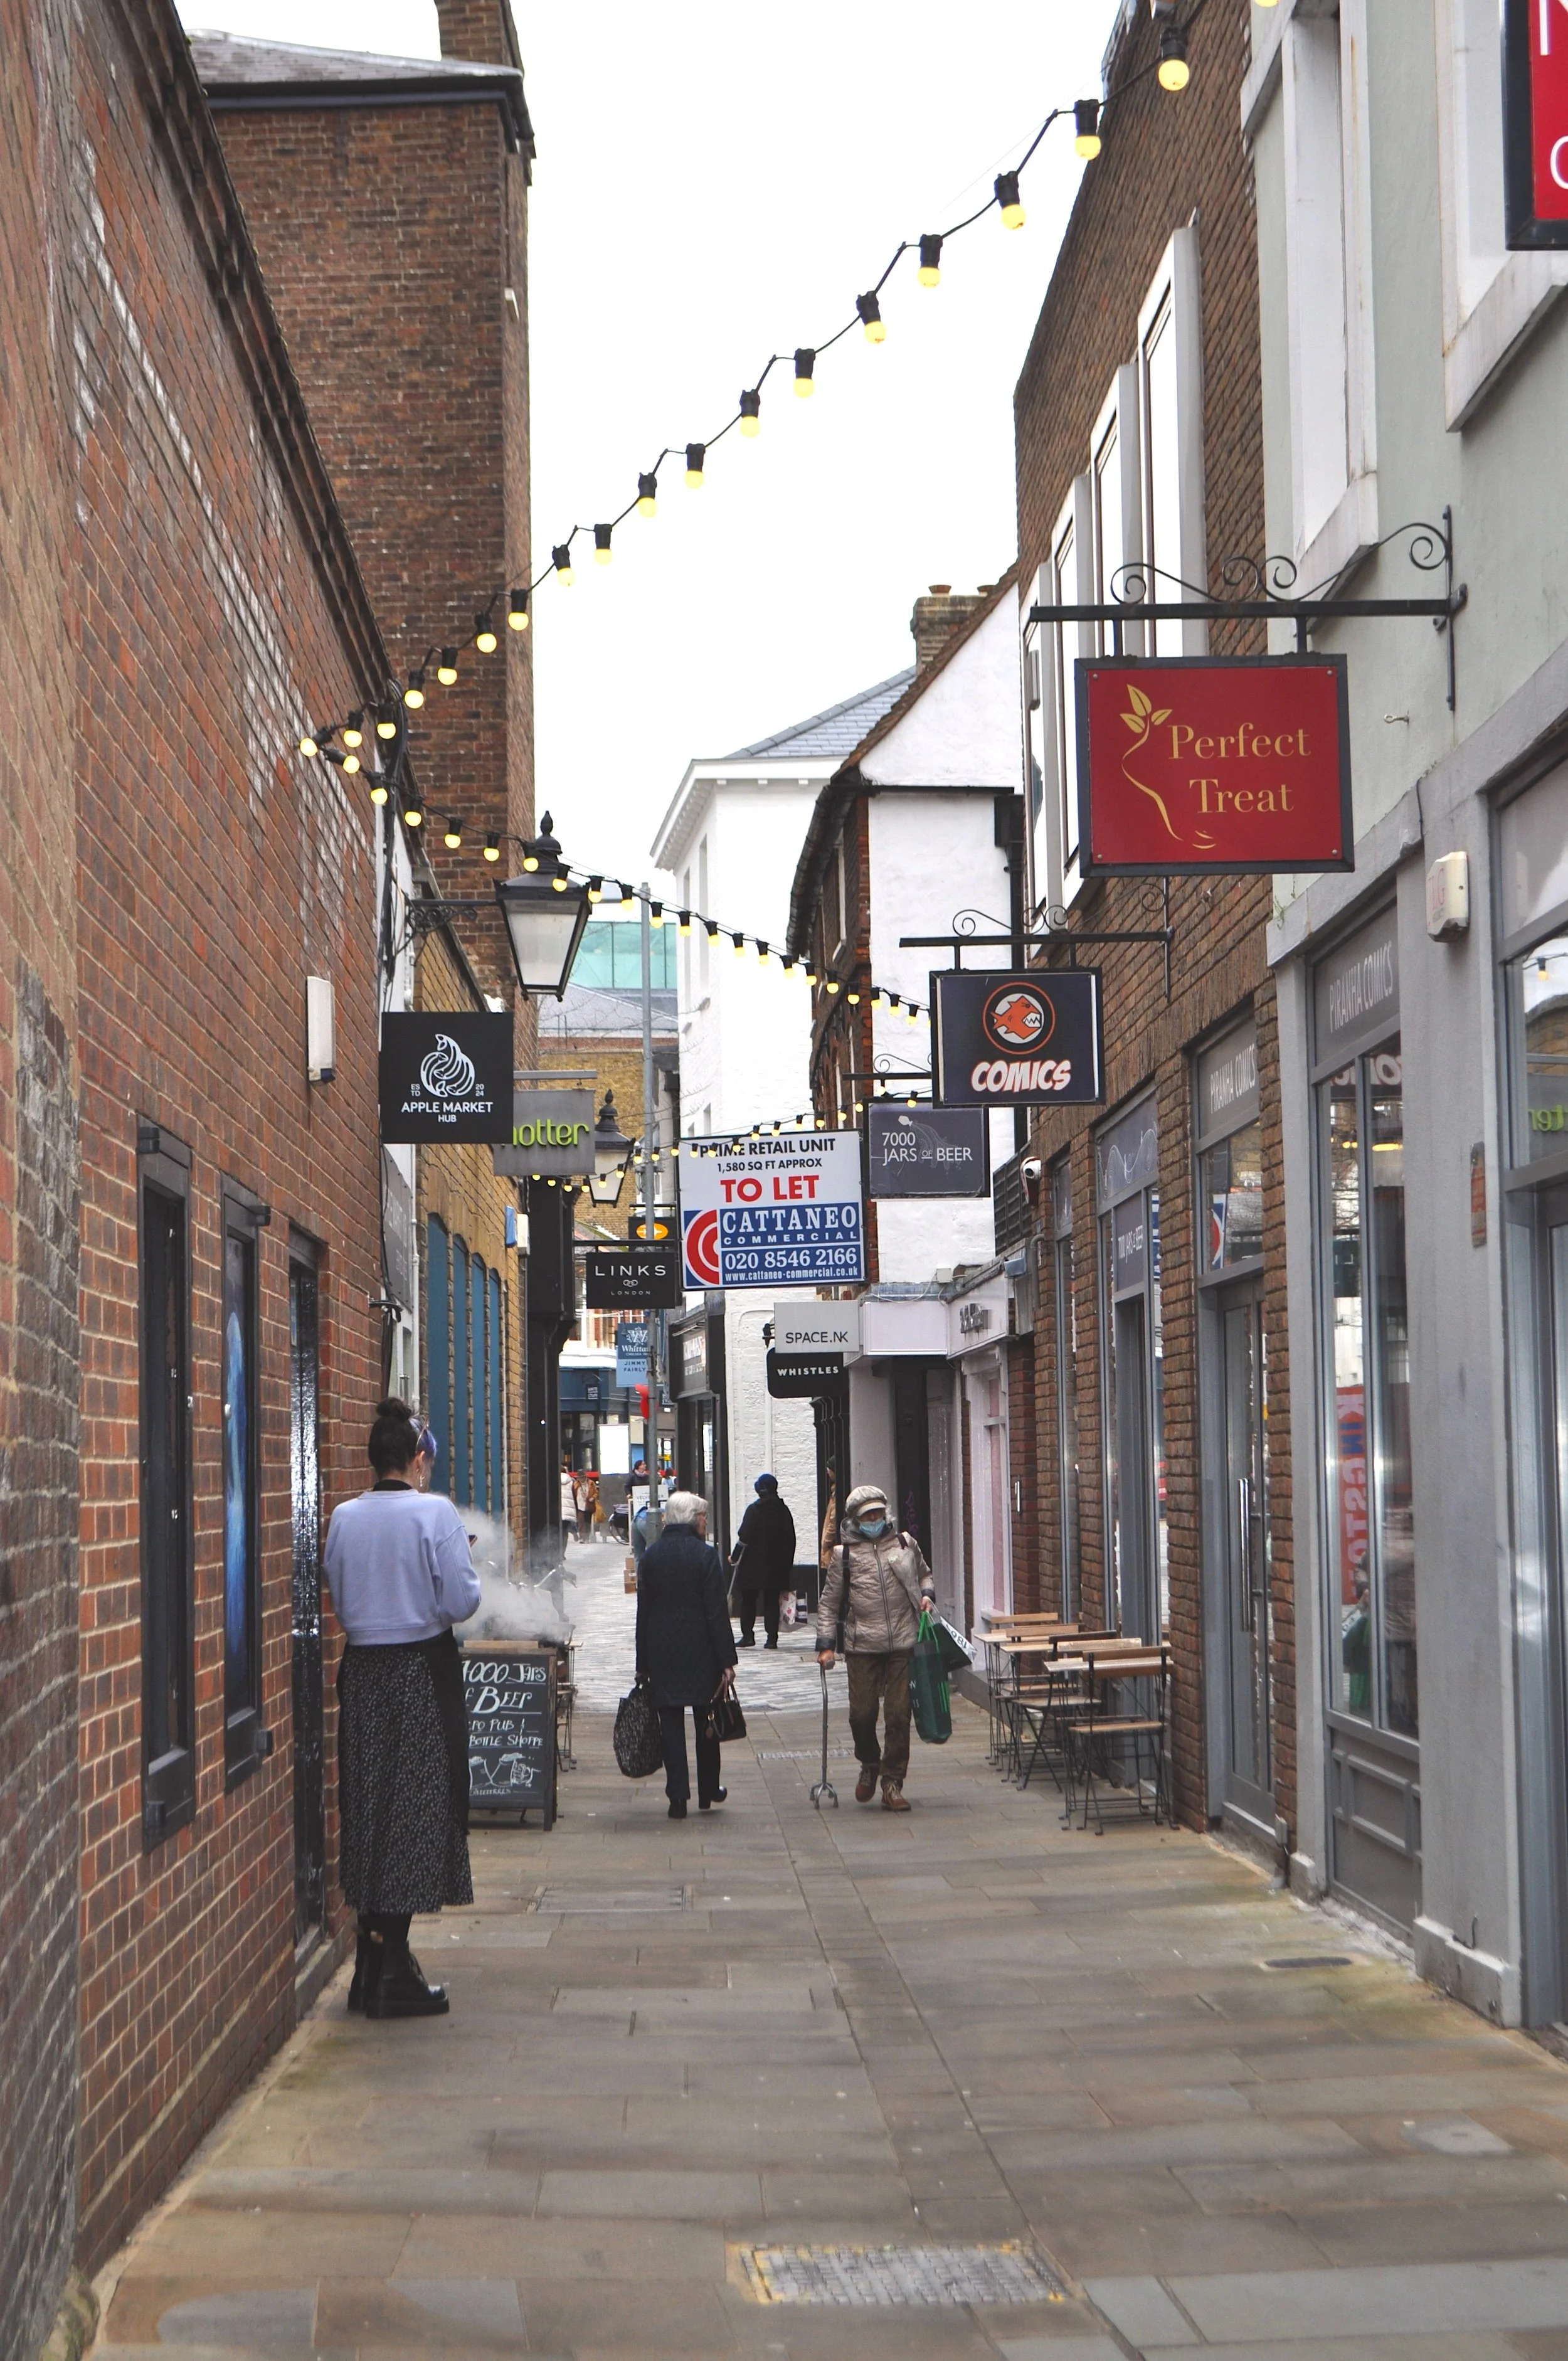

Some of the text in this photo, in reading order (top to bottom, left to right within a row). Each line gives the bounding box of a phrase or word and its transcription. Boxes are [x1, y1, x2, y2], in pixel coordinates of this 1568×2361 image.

[1167, 722, 1311, 760] Perfect
[1189, 778, 1294, 814] Treat
[1329, 940, 1393, 1034] PIRANHA COMICS
[971, 1059, 1071, 1093] COMICS
[1210, 1043, 1255, 1114] PIRANHA COMICS
[401, 1101, 494, 1113] APPLE MARKET
[438, 1114, 457, 1123] HUB
[749, 1140, 795, 1155] RETAIL
[799, 1138, 835, 1153] UNIT
[881, 1132, 916, 1147] 7000
[882, 1148, 917, 1166] JARS
[936, 1147, 973, 1162] BEER
[718, 1158, 823, 1174] 1,580 SQ FT APPROX
[720, 1175, 820, 1203] TO LET
[723, 1206, 857, 1234] CATTANEO
[723, 1231, 857, 1245] COMMERCIAL
[724, 1247, 857, 1270] 020 8546 2166
[595, 1265, 666, 1276] LINKS
[725, 1266, 858, 1281] www.cattaneo-commercial.co.uk
[785, 1331, 849, 1344] SPACE.NK
[777, 1366, 839, 1376] WHISTLES
